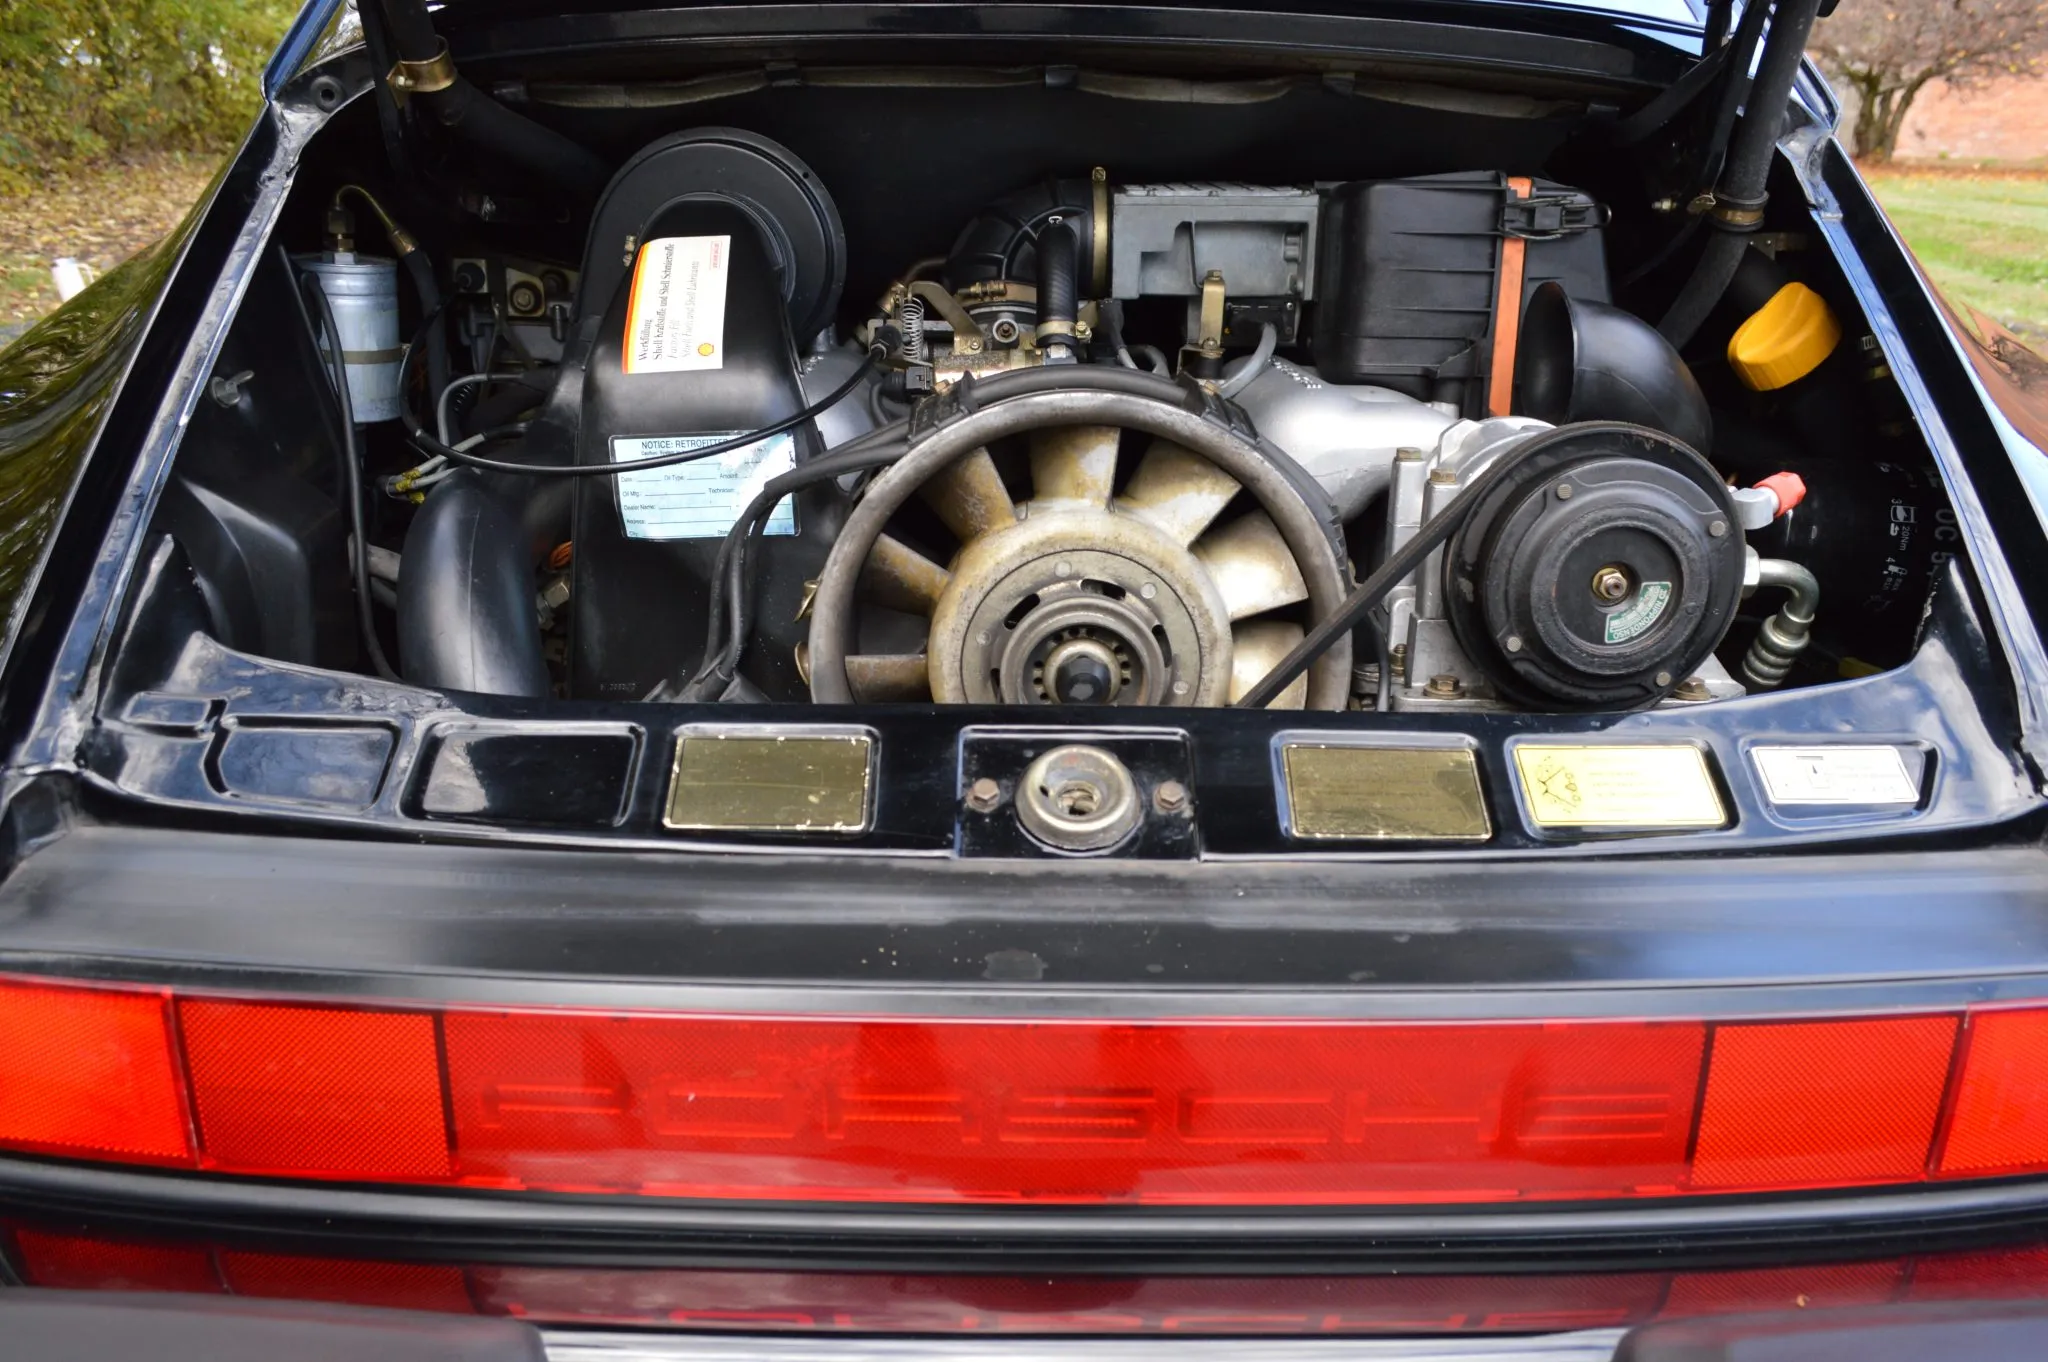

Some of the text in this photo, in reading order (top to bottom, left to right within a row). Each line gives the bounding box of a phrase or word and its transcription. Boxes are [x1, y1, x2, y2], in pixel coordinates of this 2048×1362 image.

[652, 339, 664, 361] Shell
[660, 280, 671, 296] Shell
[641, 440, 674, 450] NOTICE:
[1899, 524, 1911, 551] 20Nm
[478, 1076, 1672, 1145] PORSCHE
